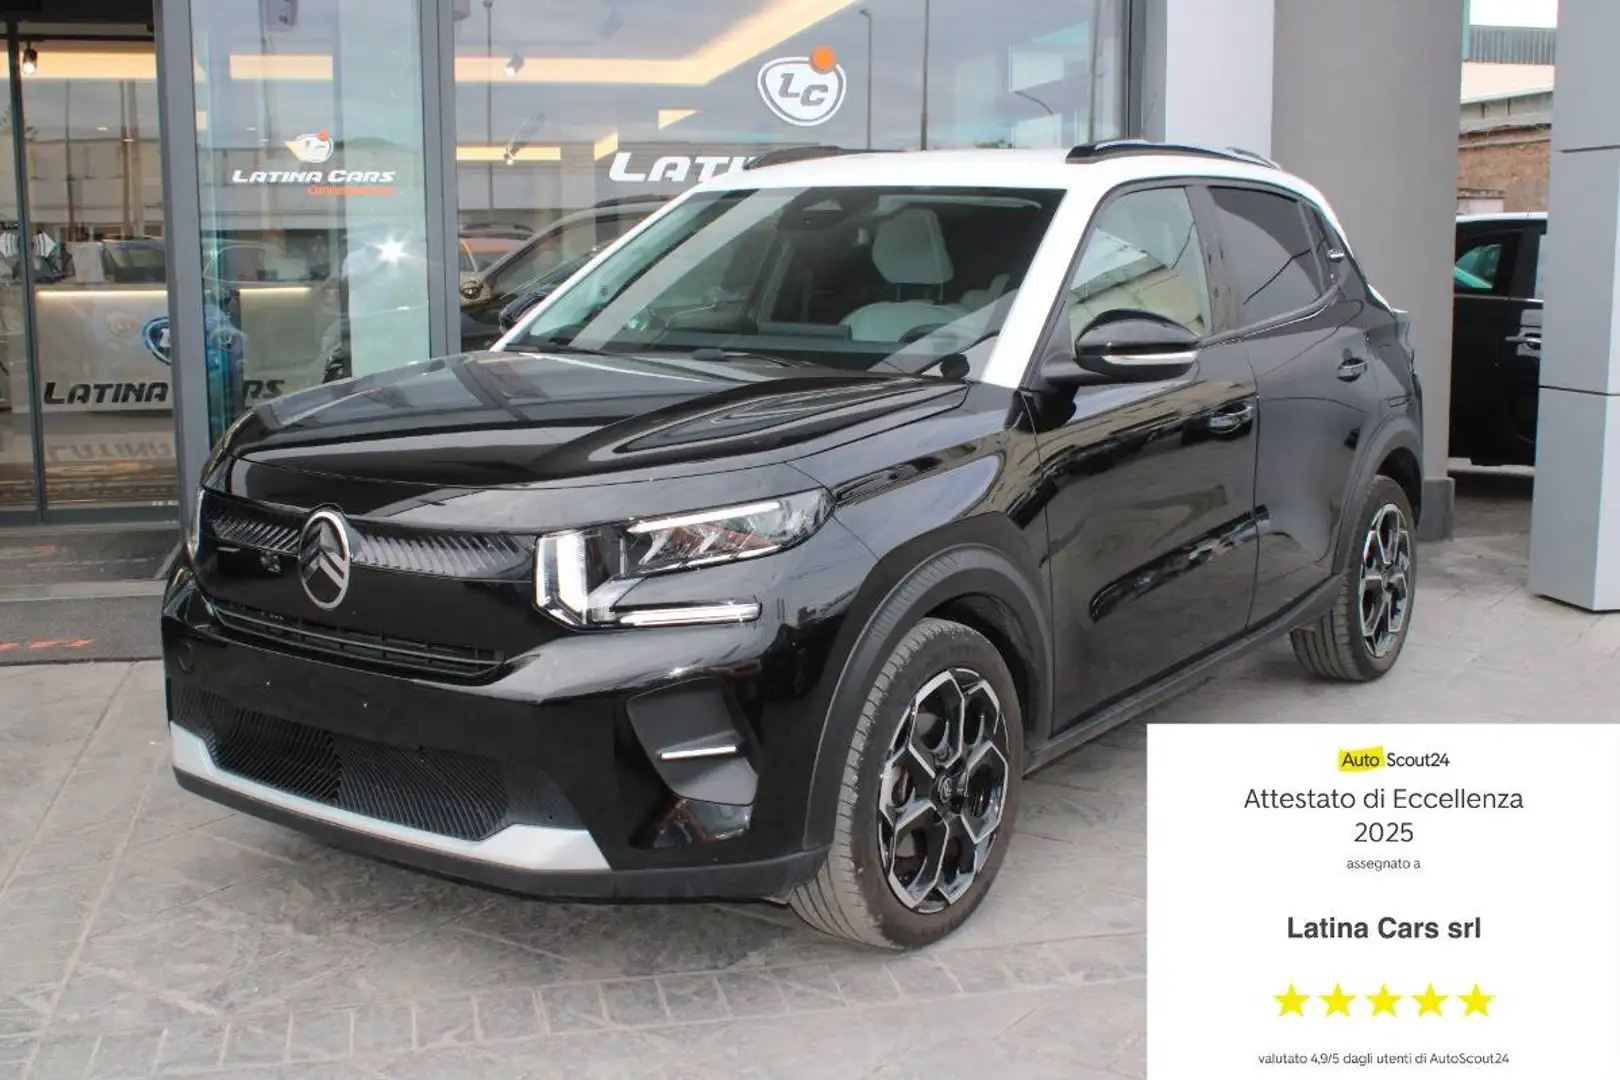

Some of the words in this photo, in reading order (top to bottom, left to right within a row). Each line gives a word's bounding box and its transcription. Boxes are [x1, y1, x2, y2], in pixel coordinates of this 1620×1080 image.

[232, 169, 323, 183] LATINA
[327, 169, 397, 183] CARS
[608, 152, 757, 183] LATI
[43, 381, 169, 405] LATINA
